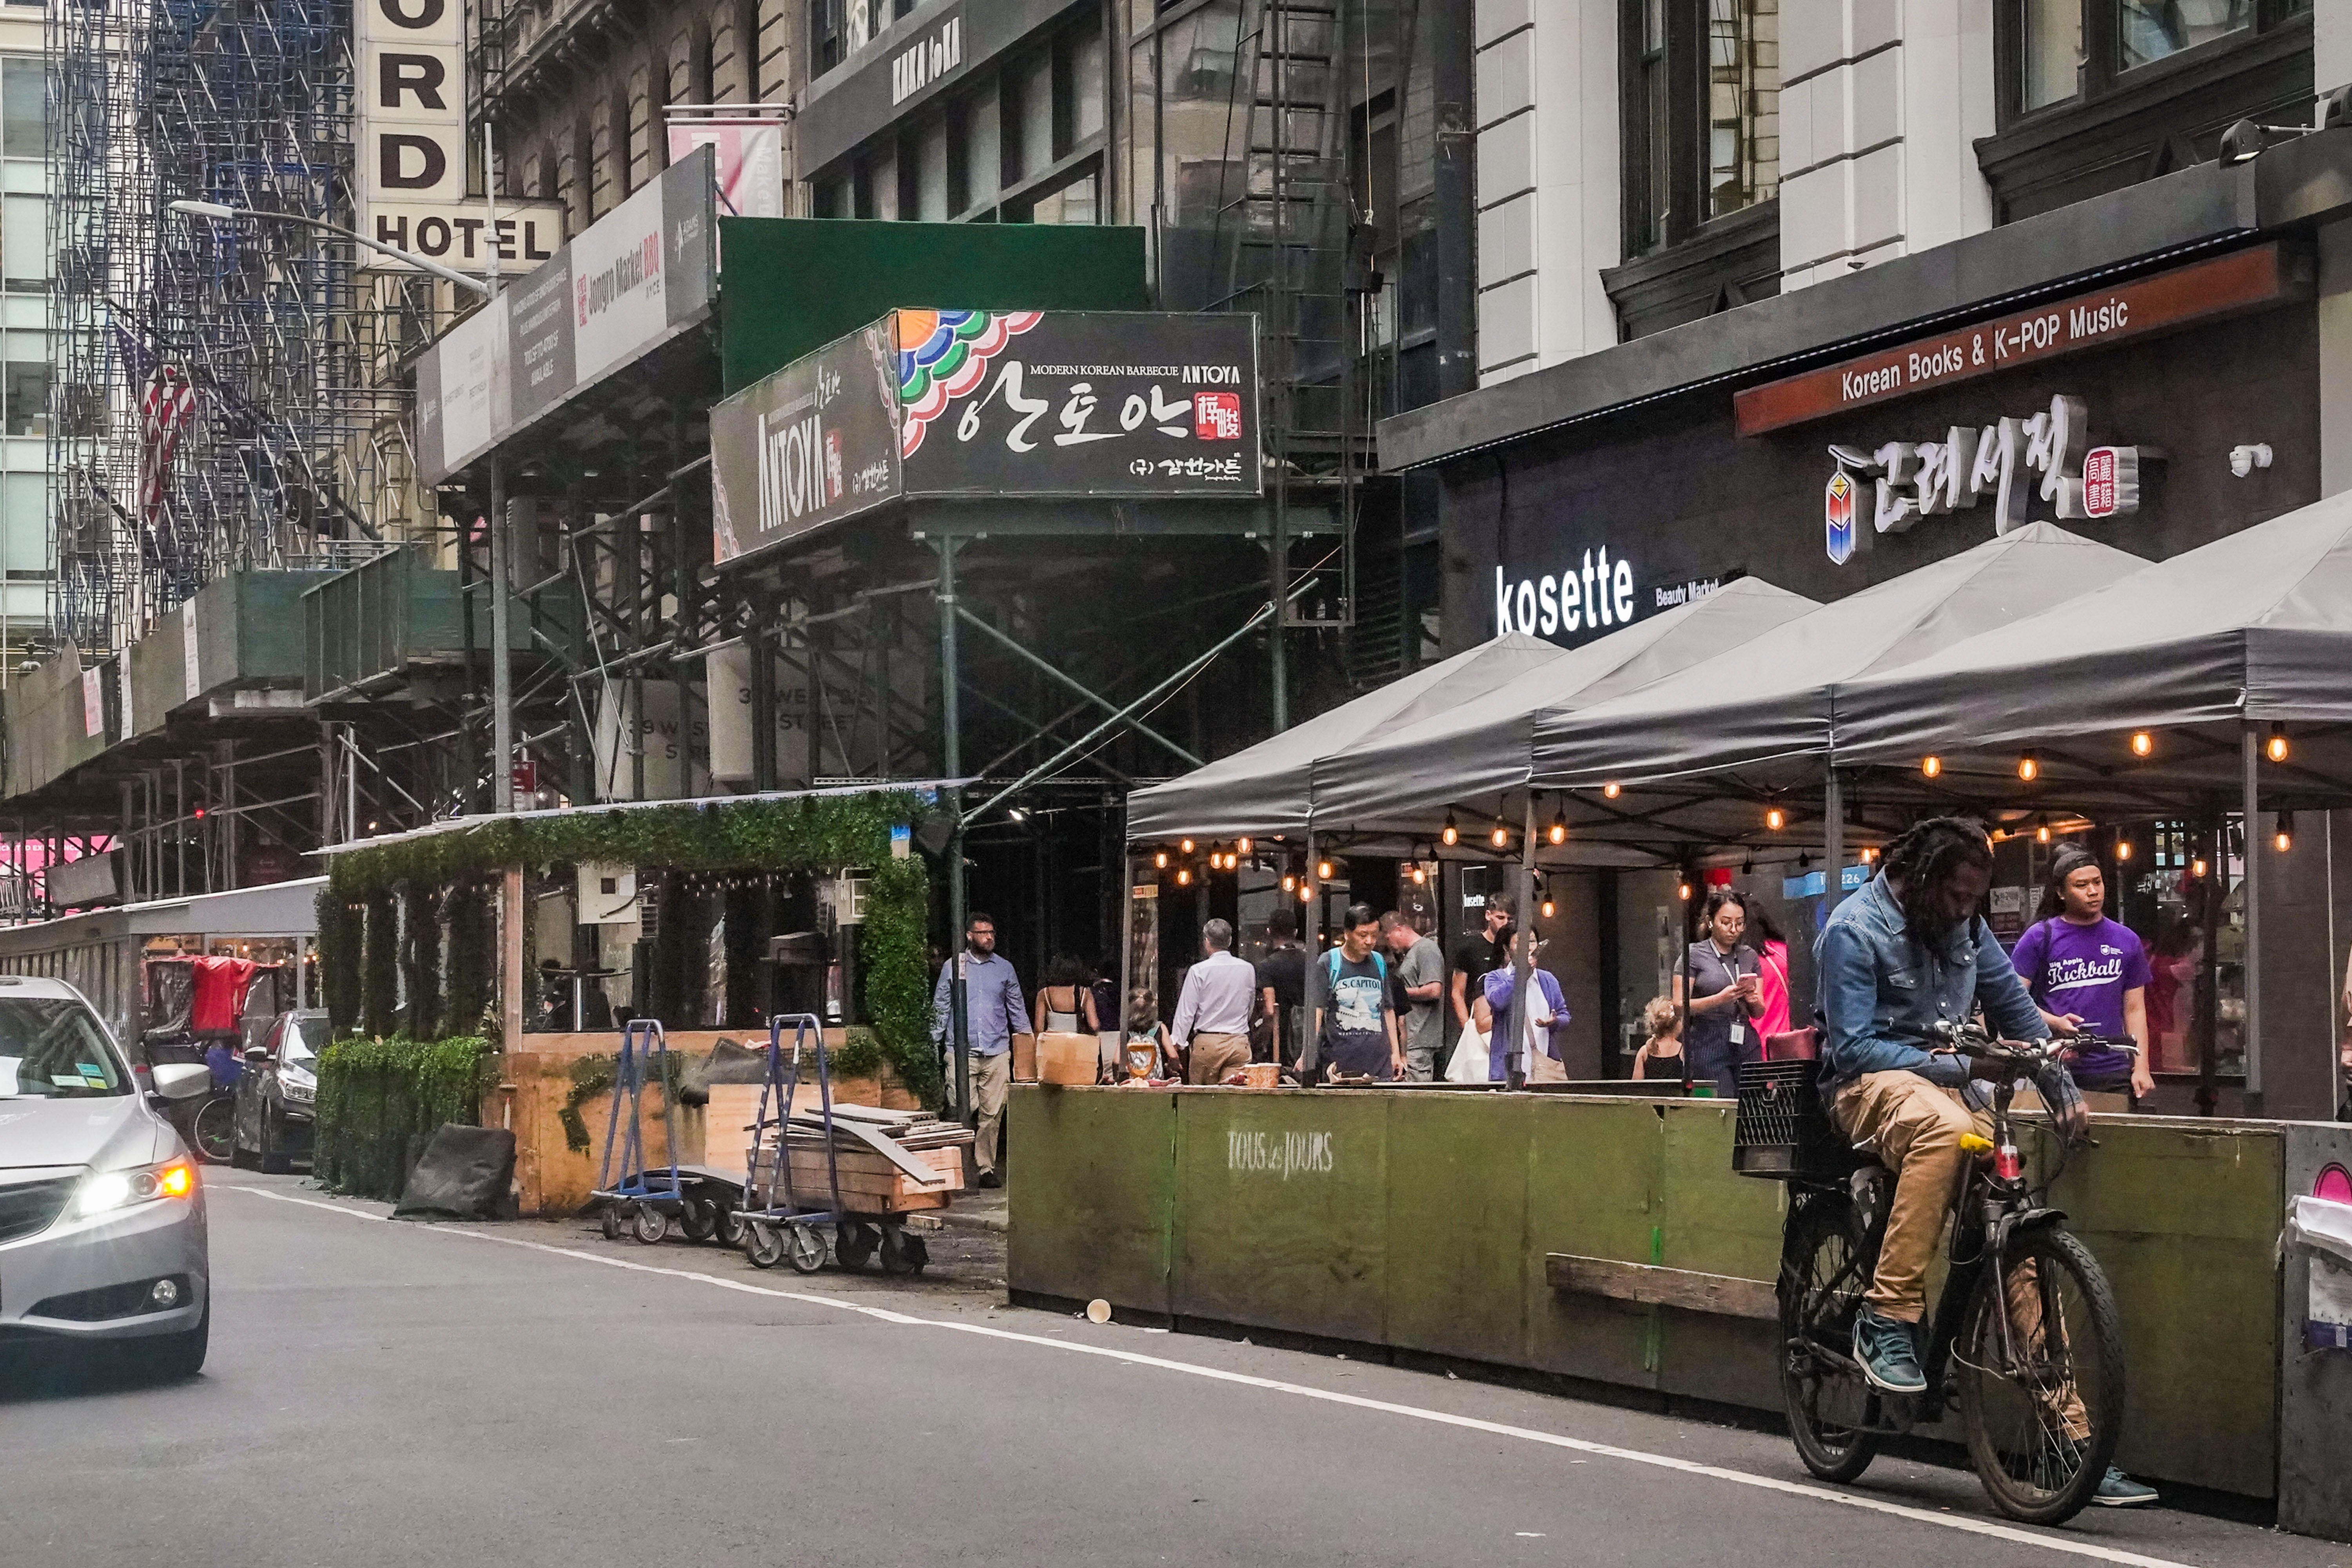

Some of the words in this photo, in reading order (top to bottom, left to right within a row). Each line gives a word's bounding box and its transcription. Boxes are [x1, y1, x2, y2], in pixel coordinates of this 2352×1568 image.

[376, 216, 551, 260] HOTEL
[588, 267, 615, 316] Jongro
[616, 243, 643, 298] Market
[644, 230, 659, 279] BBQ
[1842, 363, 1901, 401] Korean
[1909, 344, 1963, 383] Books
[1972, 334, 1985, 365] &
[1995, 314, 2060, 360] K-POP
[2069, 298, 2128, 339] Music
[1030, 365, 1080, 375] MODERN
[1080, 365, 1125, 376] KOREAN
[1126, 366, 1179, 376] BARBECUE
[1182, 365, 1240, 384] ANTOYA
[758, 413, 826, 532] ANTOYA
[1496, 544, 1634, 637] kosette
[1655, 586, 1686, 607] Beauty
[2048, 958, 2123, 985] Kickball
[2062, 957, 2083, 966] Apple
[1228, 1131, 1266, 1170] TOUS
[1283, 1131, 1333, 1181] JOURS
